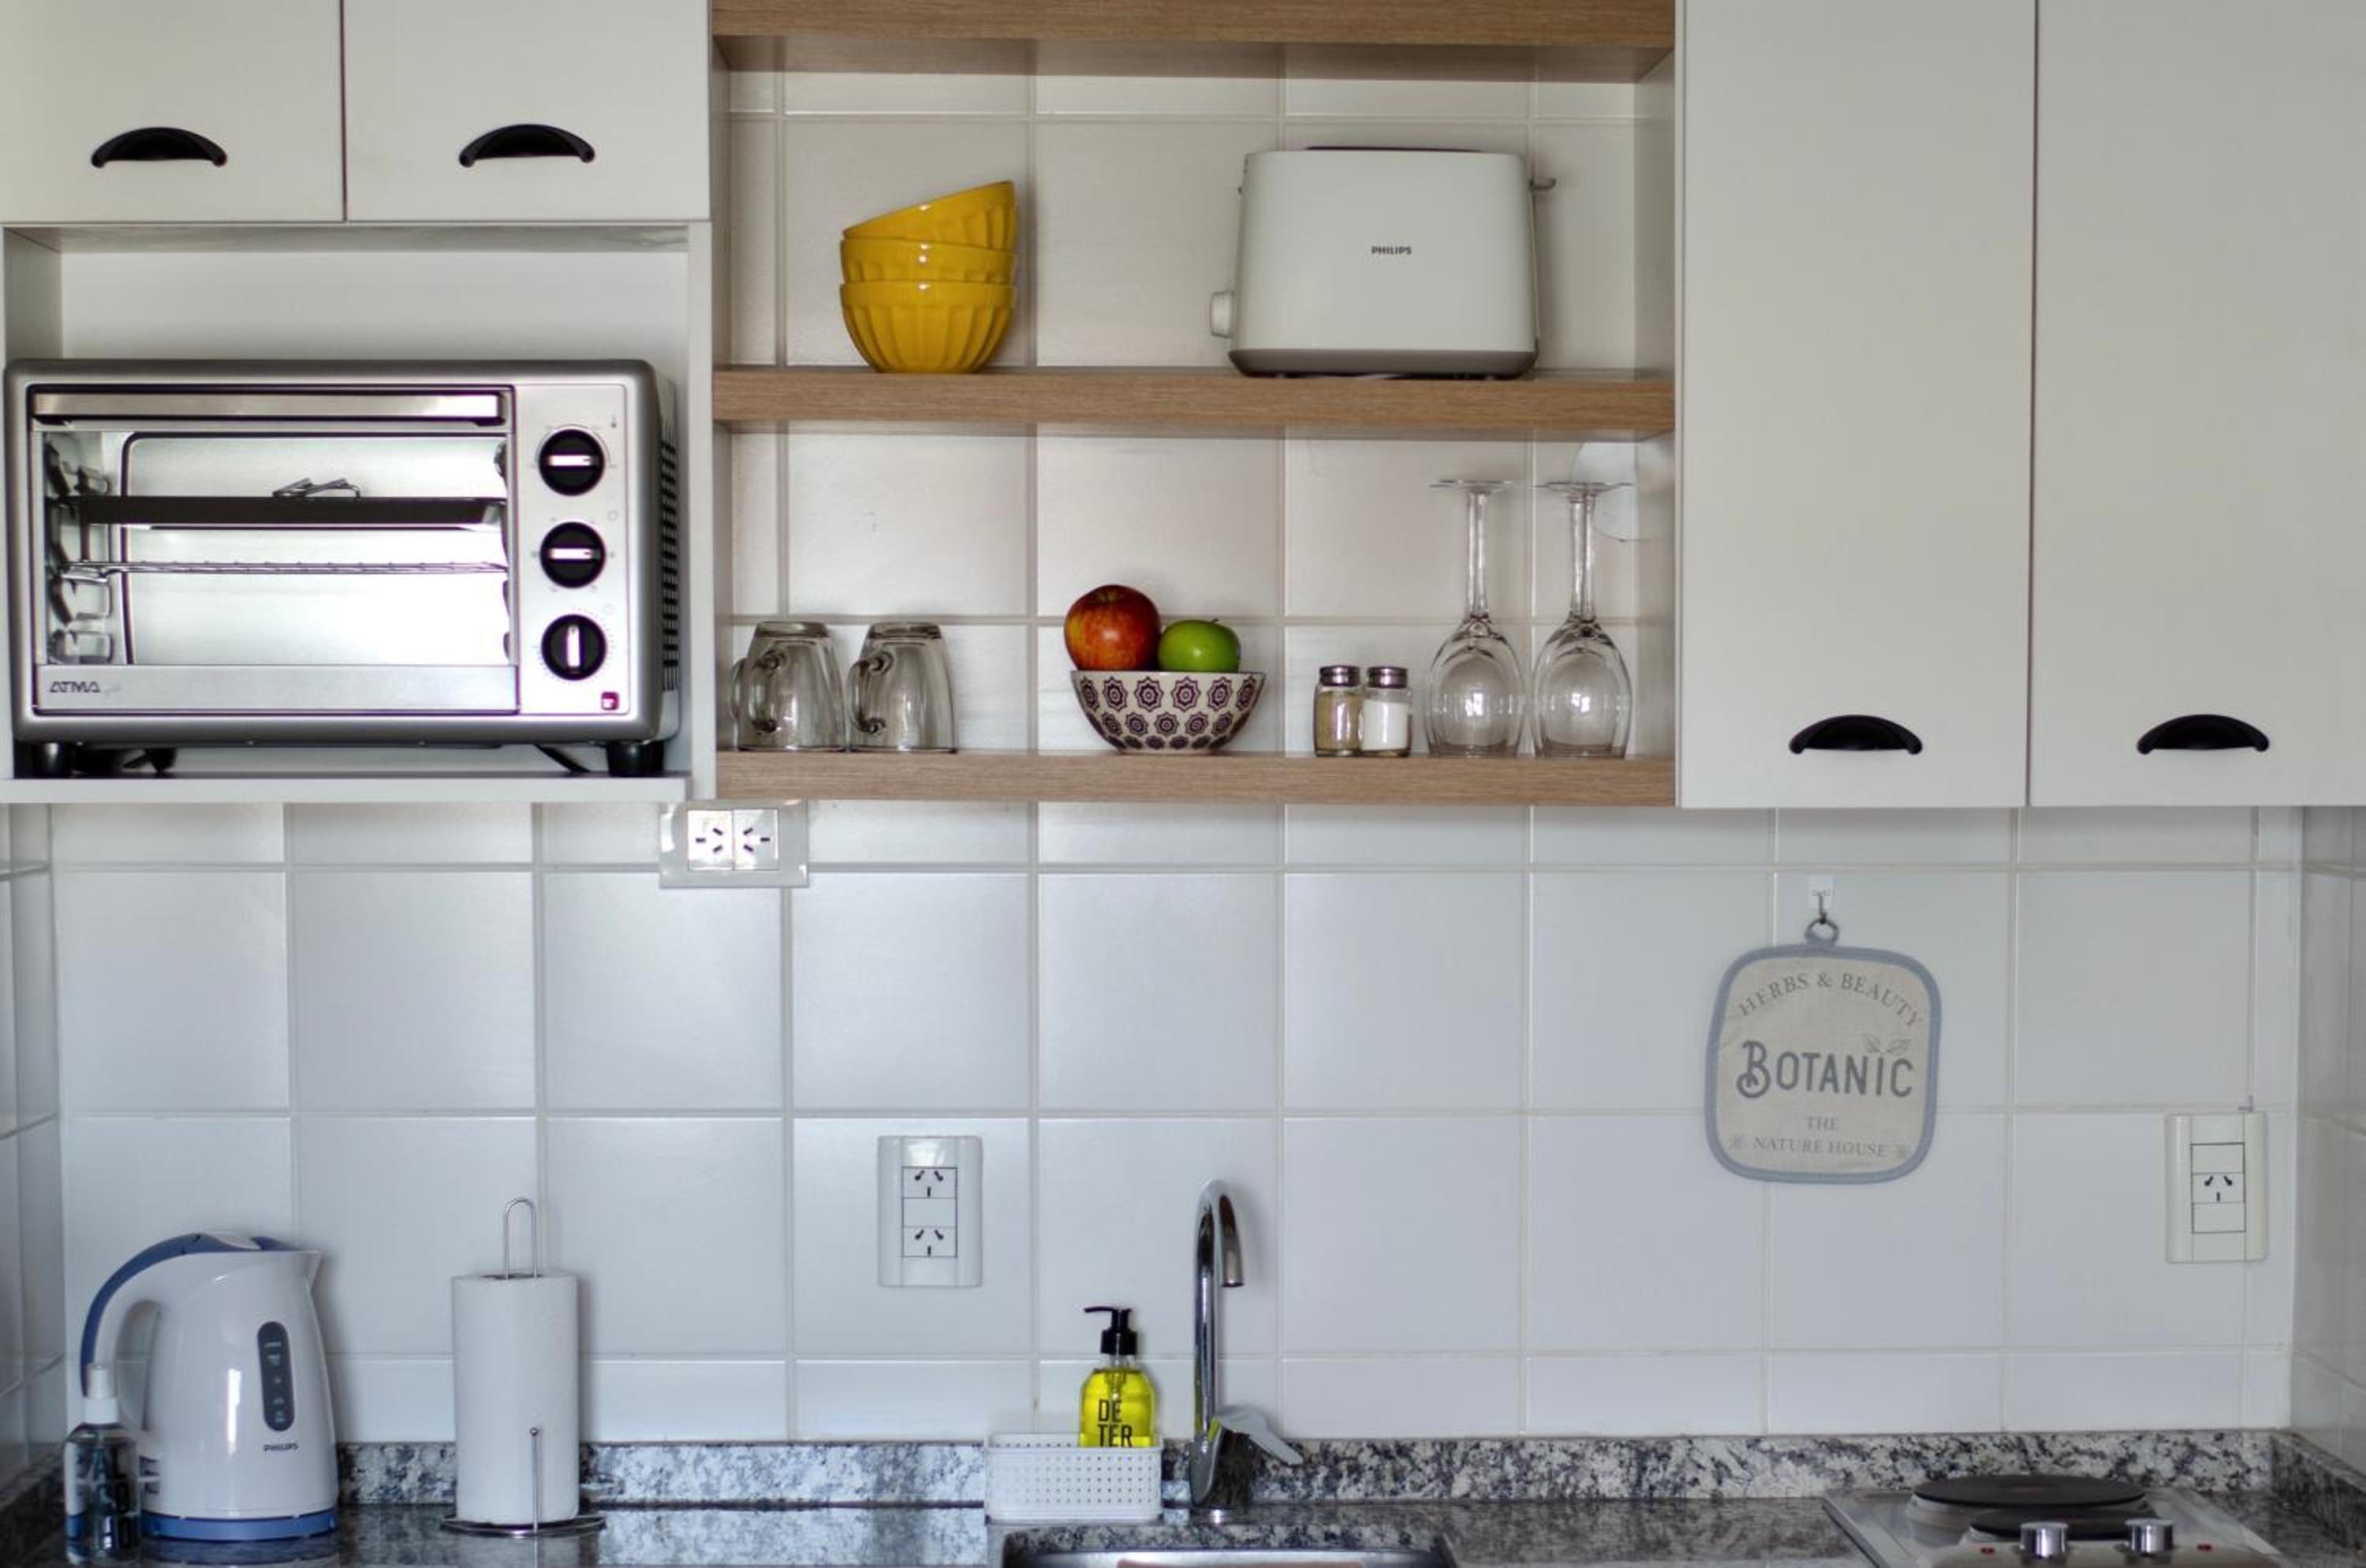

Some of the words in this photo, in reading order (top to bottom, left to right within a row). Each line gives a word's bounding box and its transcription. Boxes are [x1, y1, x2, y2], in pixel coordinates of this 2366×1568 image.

[1371, 245, 1413, 255] PHILIPS
[50, 681, 101, 693] ATMA
[1738, 973, 1808, 1016] HERBS
[1816, 972, 1832, 987] &
[1842, 973, 1923, 1027] BEAUTY
[1736, 1040, 1914, 1099] BOTANIC
[1805, 1115, 1841, 1131] THE
[1754, 1137, 1824, 1154] NATURE
[1829, 1141, 1889, 1157] HOUSE
[1099, 1398, 1122, 1422] DE
[1097, 1424, 1133, 1447] TER
[263, 1443, 299, 1452] PHILIPS
